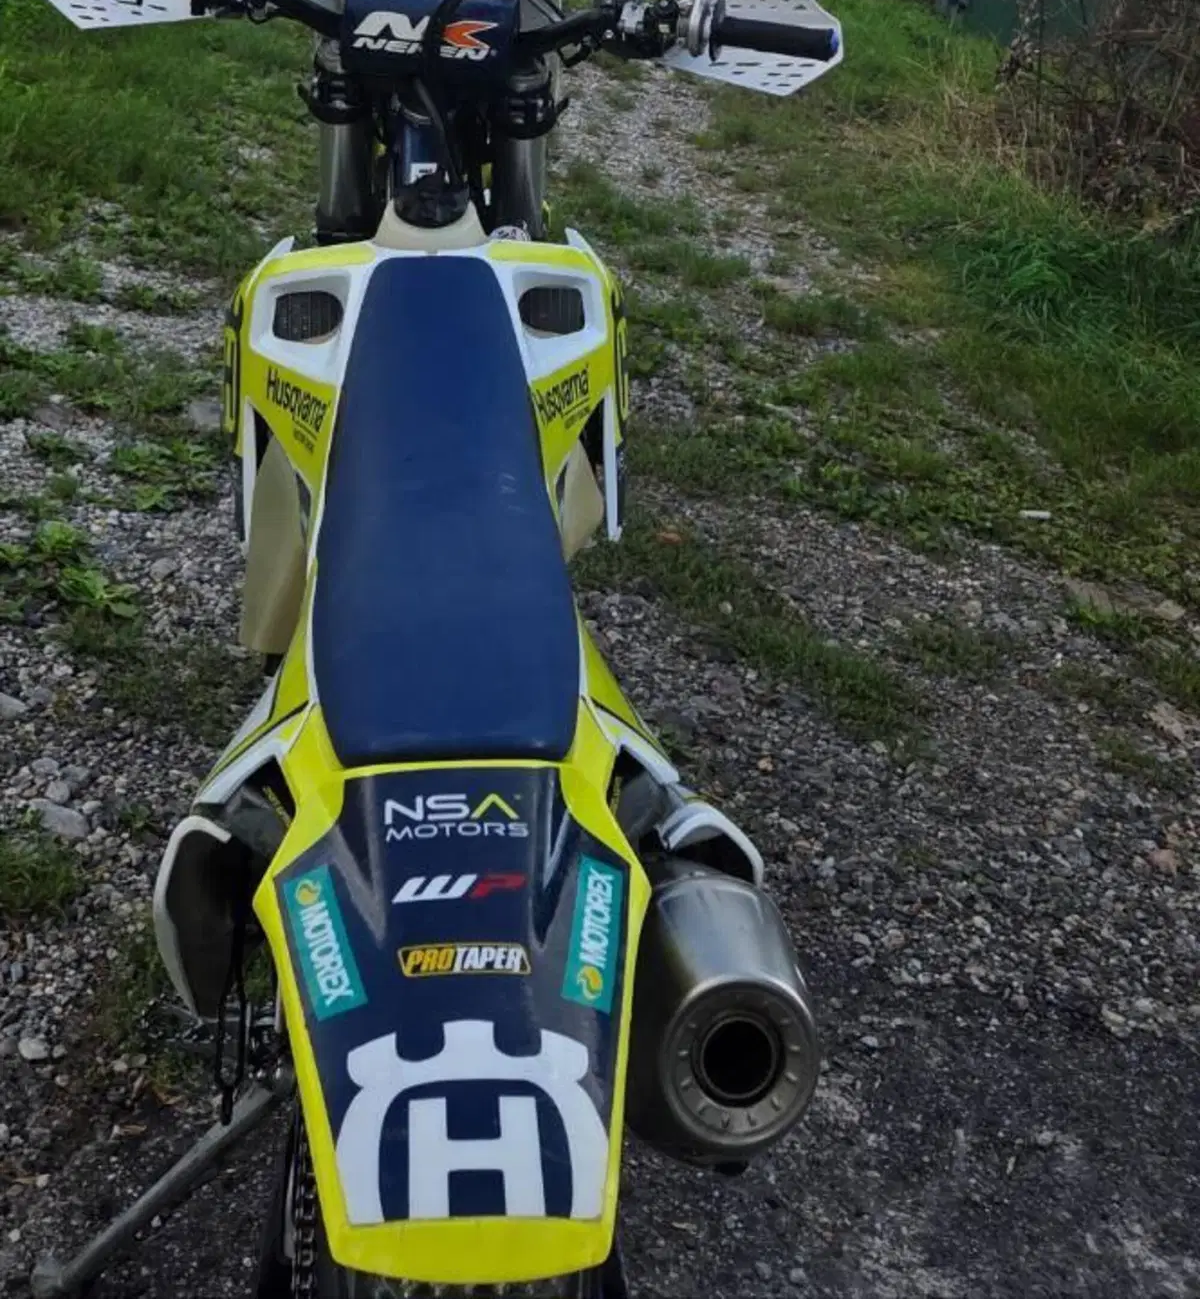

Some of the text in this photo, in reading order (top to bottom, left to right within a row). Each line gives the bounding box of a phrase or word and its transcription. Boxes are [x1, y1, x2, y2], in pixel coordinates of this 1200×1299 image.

[266, 365, 328, 434] Husqvarna
[384, 793, 519, 825] NSA
[385, 821, 529, 842] MOTORS
[391, 873, 528, 904] WP
[578, 867, 615, 969] MOTOREX
[301, 900, 355, 1006] MOTOREX
[403, 944, 524, 974] PROTAPER
[408, 1095, 546, 1219] H
